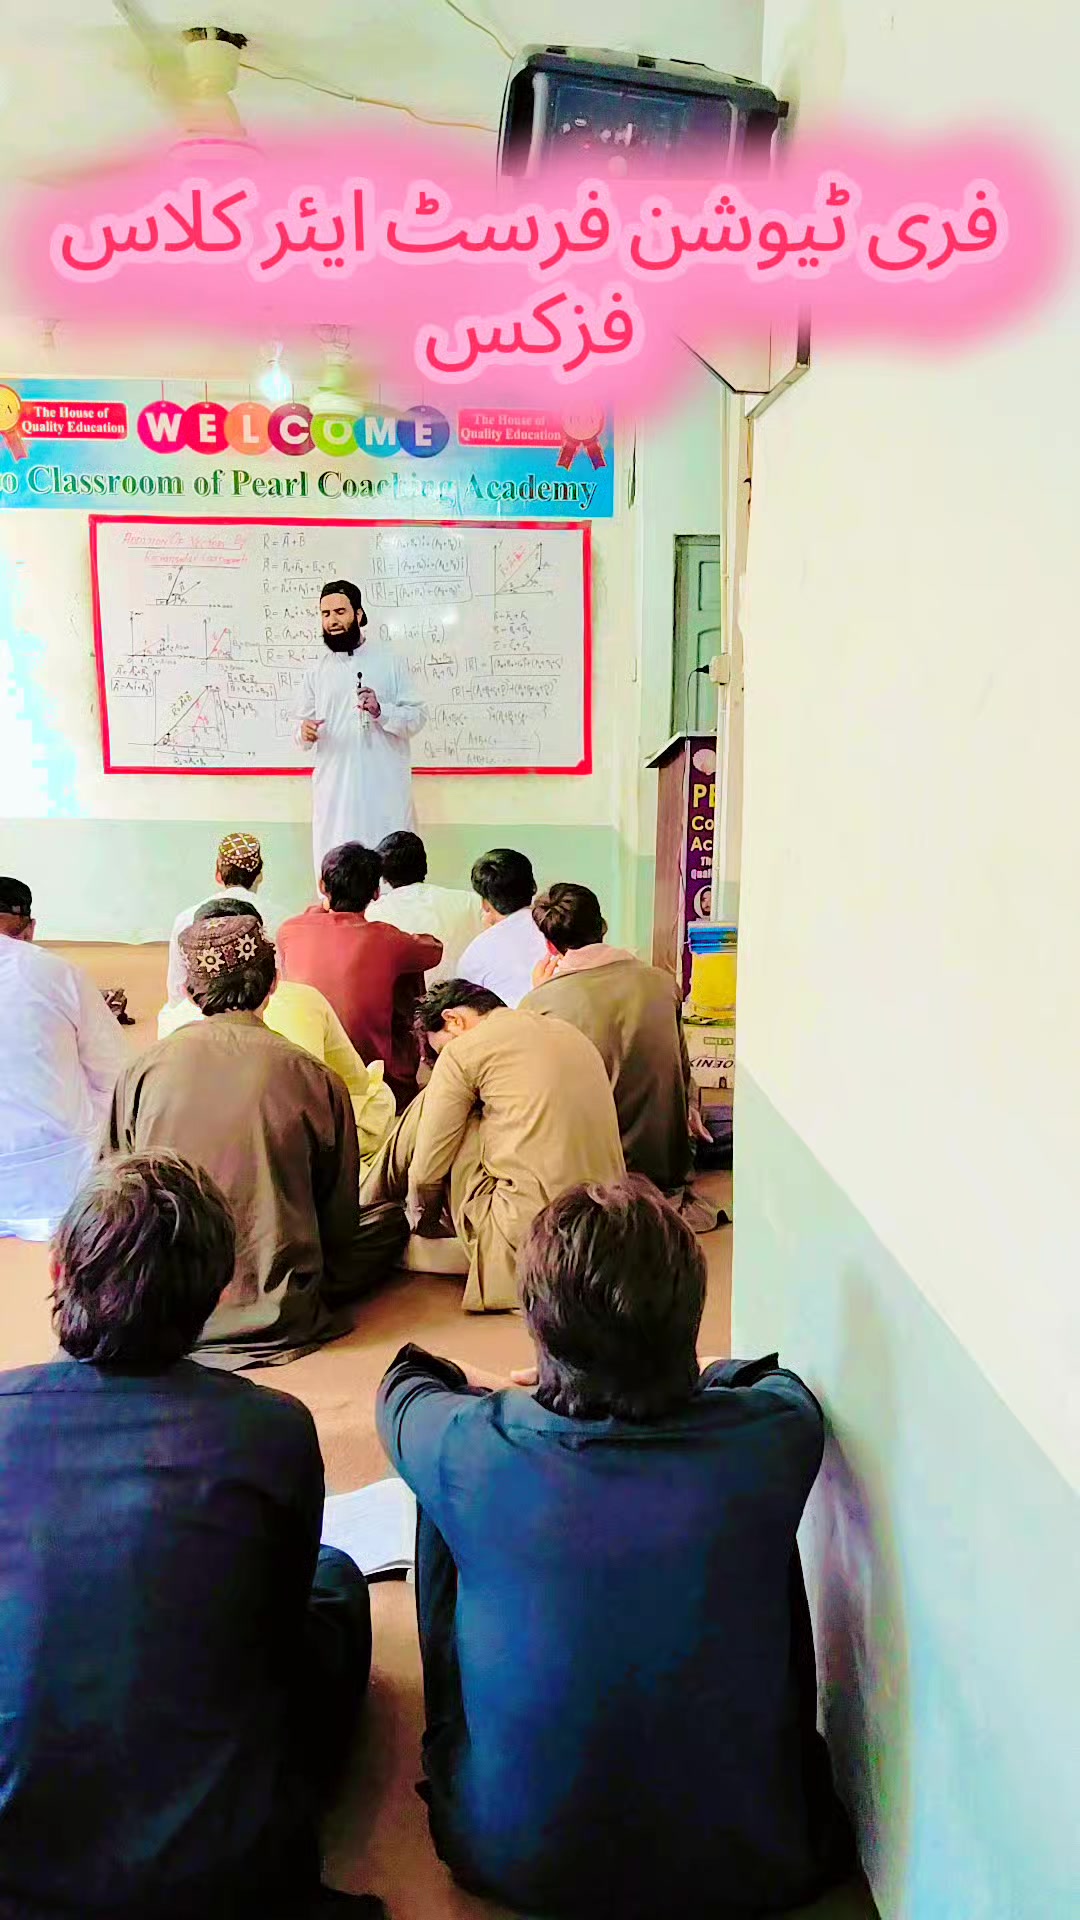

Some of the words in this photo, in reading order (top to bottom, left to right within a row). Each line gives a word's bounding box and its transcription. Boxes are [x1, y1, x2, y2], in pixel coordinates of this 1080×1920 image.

[35, 406, 56, 419] The
[60, 406, 94, 419] House
[97, 406, 110, 419] of
[474, 414, 495, 426] The
[499, 414, 532, 426] House
[22, 420, 65, 435] Quality
[67, 421, 125, 434] Education
[145, 411, 433, 447] WELCOME
[460, 427, 502, 442] Quality
[505, 429, 561, 441] Education
[27, 465, 185, 497] Classroom
[193, 469, 225, 497] of
[231, 469, 309, 498] Pearl
[318, 470, 456, 508] Coaching
[465, 473, 598, 510] Academy
